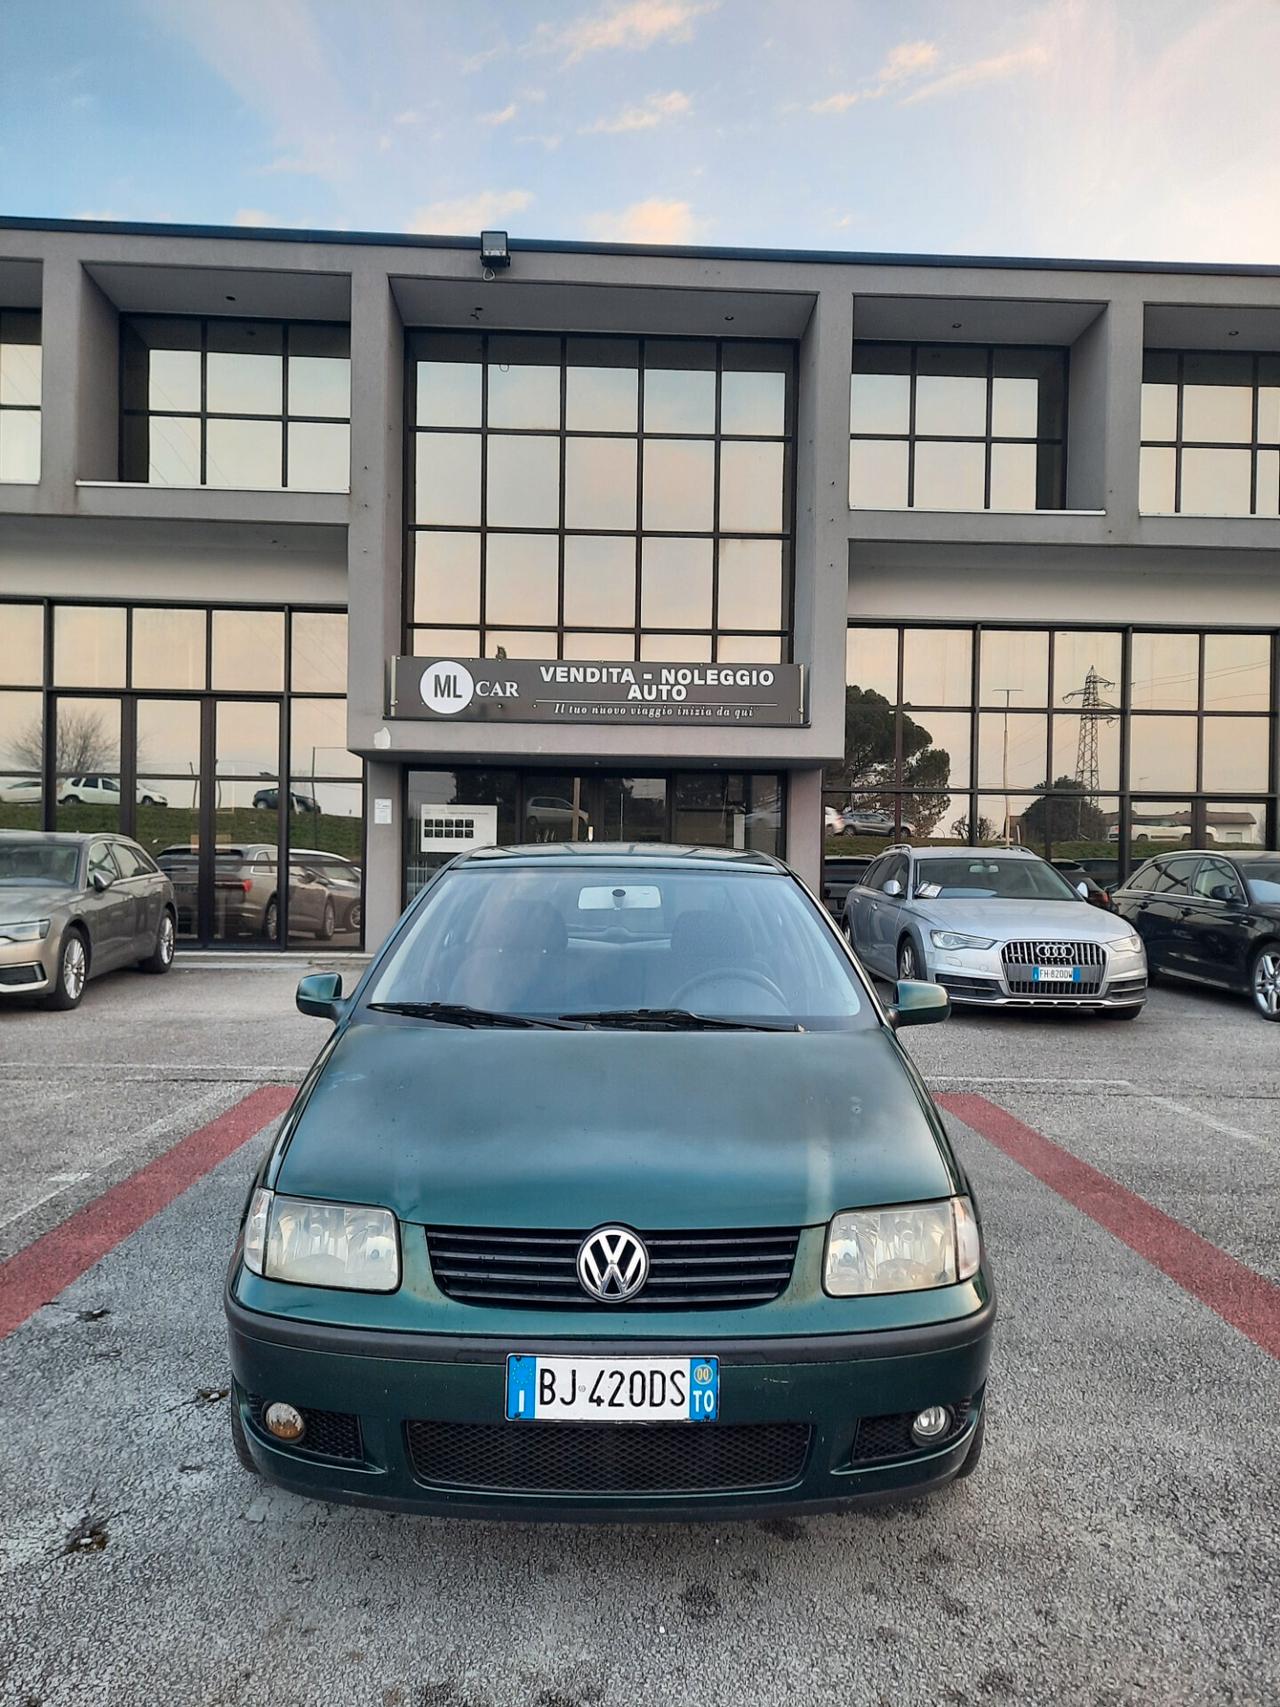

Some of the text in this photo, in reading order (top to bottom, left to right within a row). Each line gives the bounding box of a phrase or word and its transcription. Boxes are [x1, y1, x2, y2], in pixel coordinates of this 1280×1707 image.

[434, 674, 519, 698] ML CAR
[540, 666, 636, 684] VENDITA
[661, 668, 775, 686] NOLEGGIO
[627, 684, 687, 701] AUTO
[554, 703, 754, 720] Il tuo nuovo viaggio inizia da qui
[1040, 969, 1049, 979] FH
[580, 1228, 646, 1300] VW
[697, 1369, 710, 1380] 00
[539, 1368, 686, 1408] BJ 420DS
[518, 1390, 525, 1413] I
[693, 1390, 715, 1413] TO
